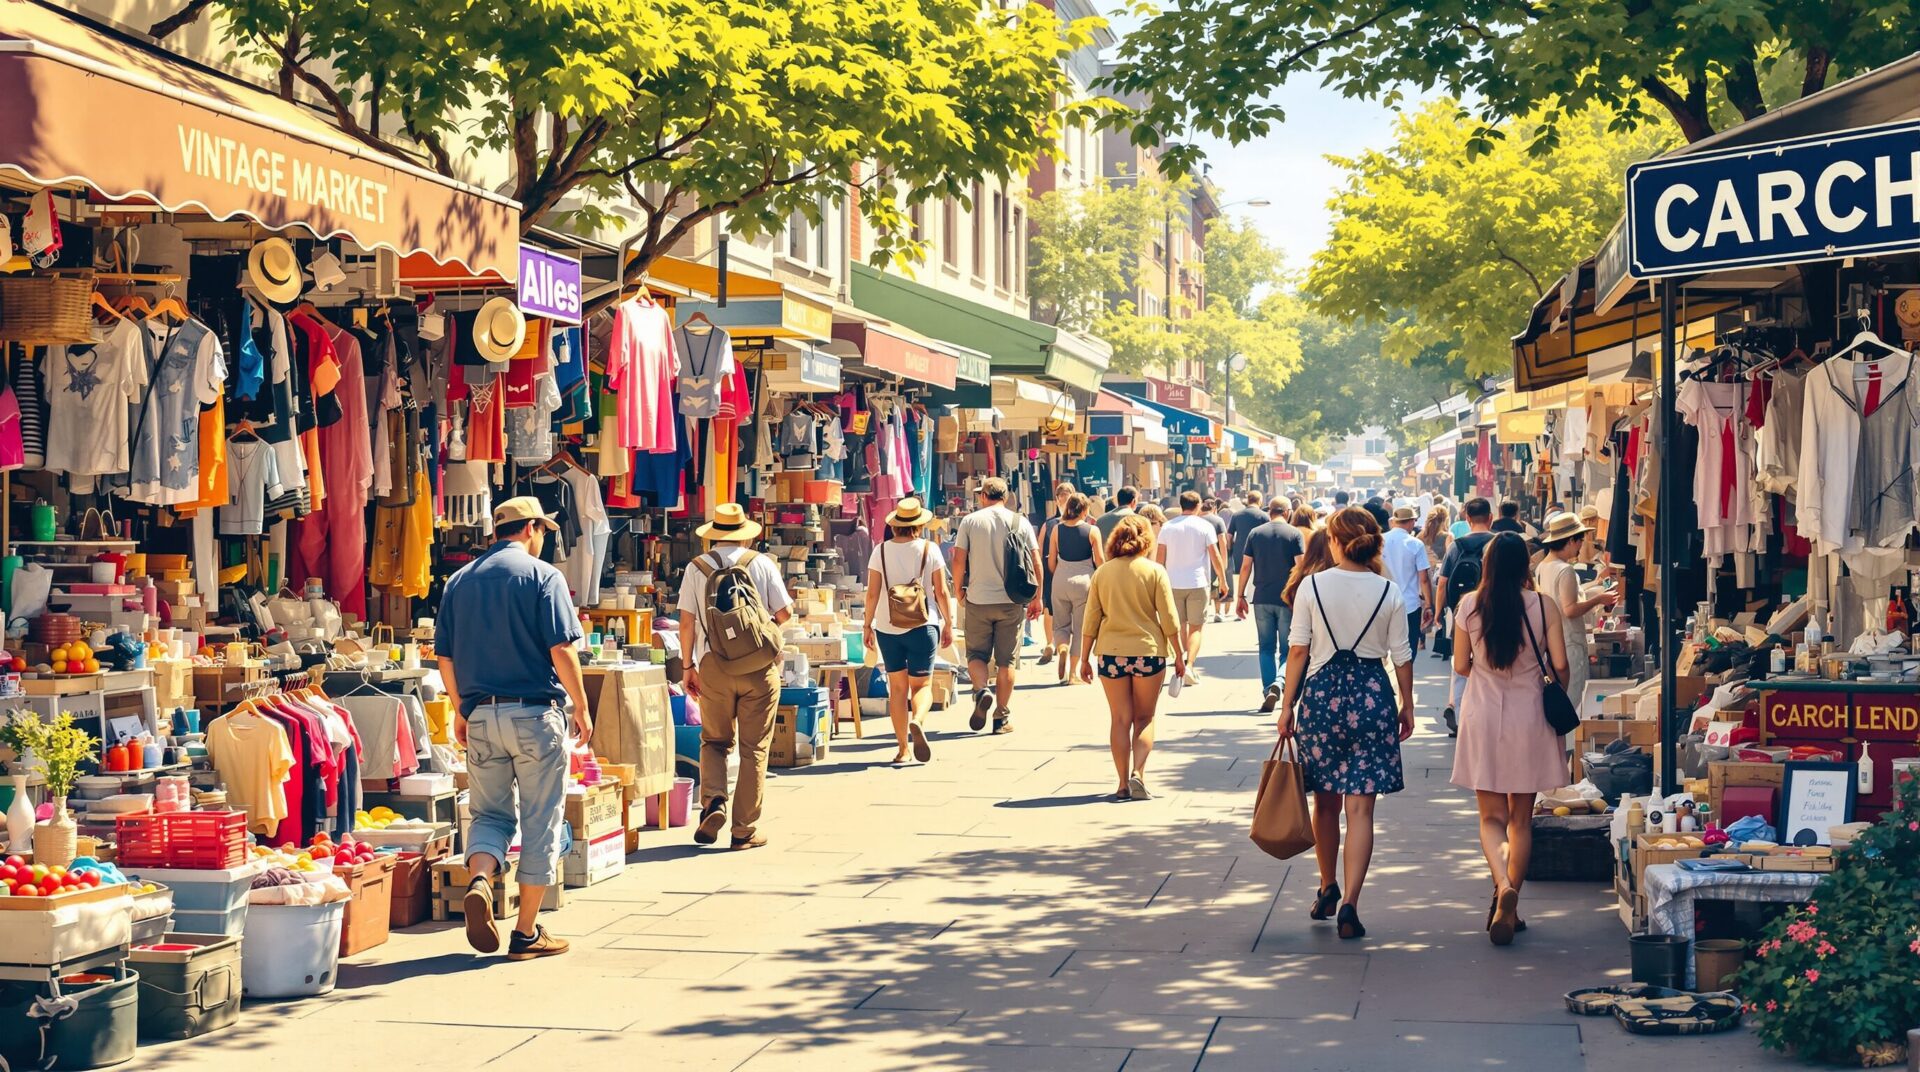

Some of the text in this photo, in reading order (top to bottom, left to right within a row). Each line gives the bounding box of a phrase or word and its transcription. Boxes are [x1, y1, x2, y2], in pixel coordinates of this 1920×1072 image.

[178, 124, 388, 224] VINTAGE MARKET
[1654, 151, 1920, 252] CARCH
[521, 258, 580, 314] Alles
[1771, 704, 1919, 731] CARCH LEND
